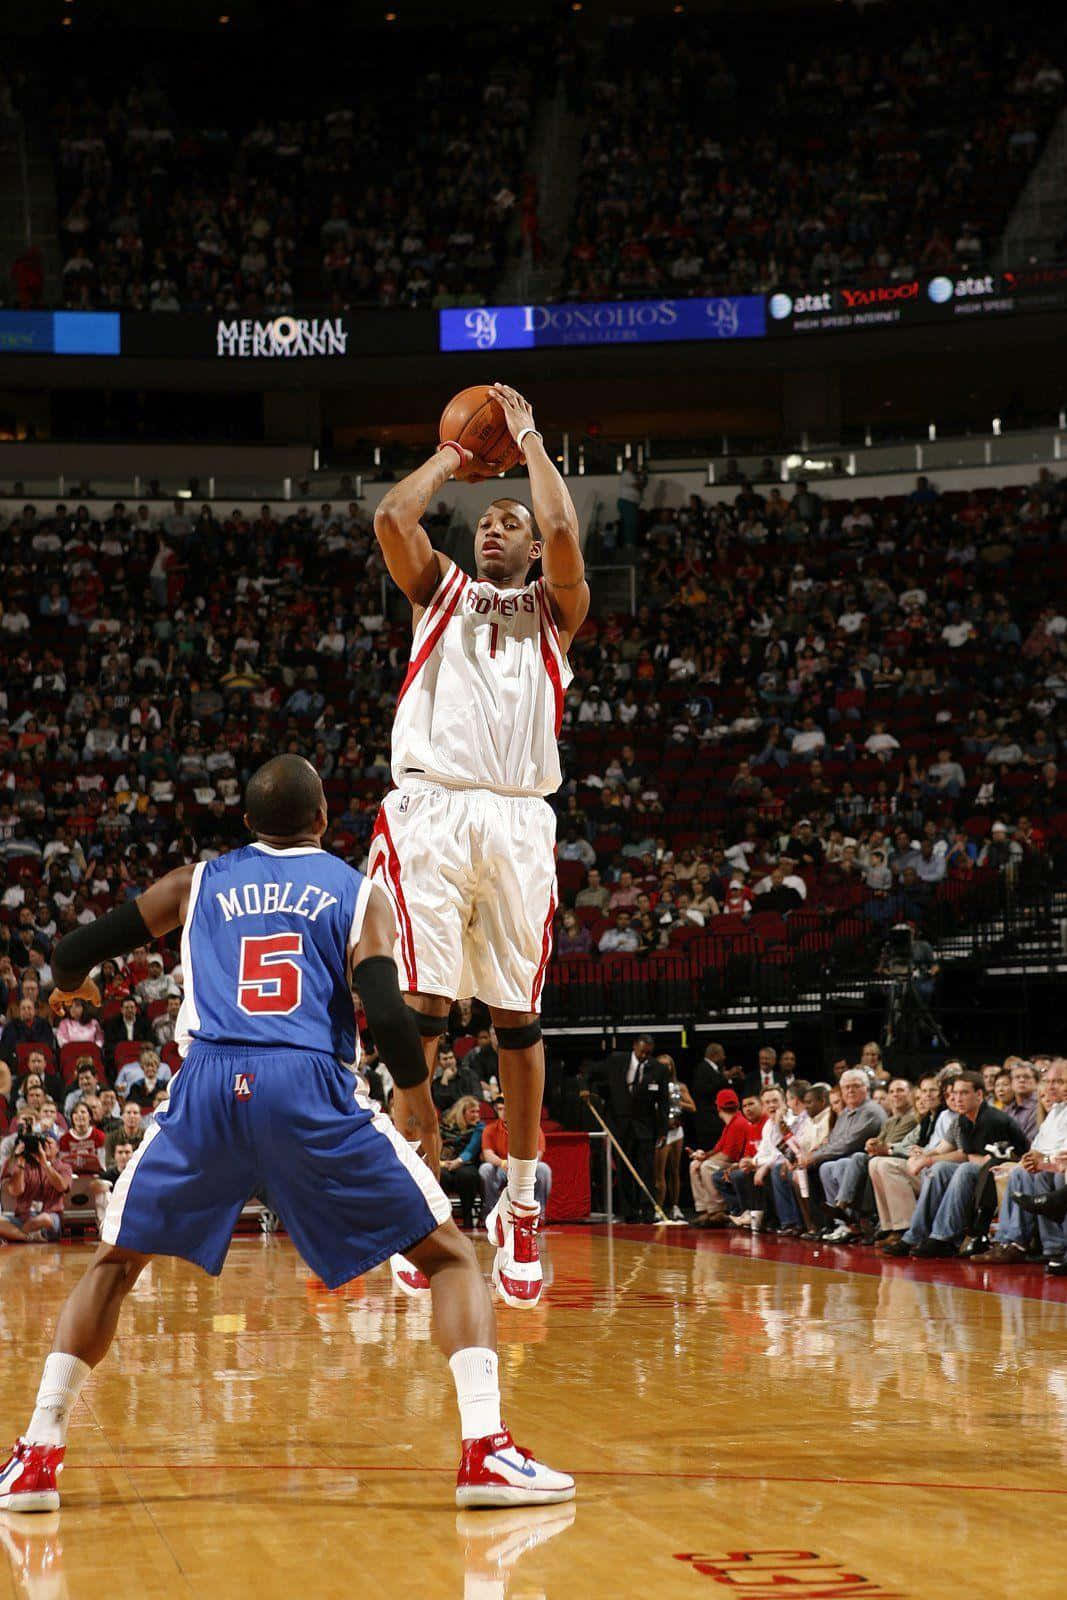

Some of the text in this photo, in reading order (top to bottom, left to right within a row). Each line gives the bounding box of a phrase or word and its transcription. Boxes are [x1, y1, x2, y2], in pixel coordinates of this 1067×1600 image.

[216, 335, 346, 356] HERMANN
[217, 316, 348, 342] MEMORIAL
[466, 588, 535, 617] ROKETS
[489, 622, 499, 659] 1
[216, 881, 338, 922] MOBLEY
[236, 932, 304, 1016] 5
